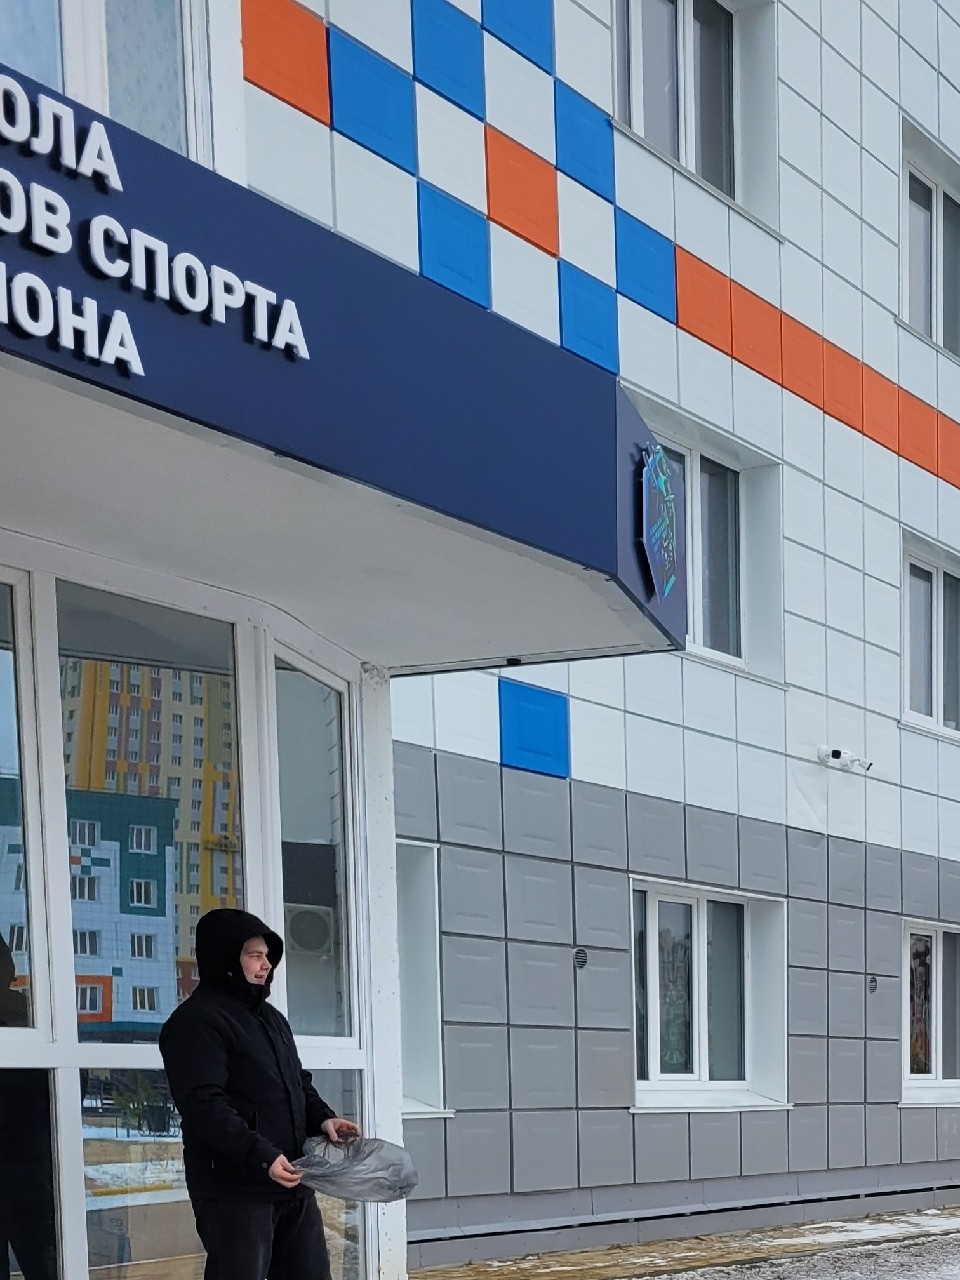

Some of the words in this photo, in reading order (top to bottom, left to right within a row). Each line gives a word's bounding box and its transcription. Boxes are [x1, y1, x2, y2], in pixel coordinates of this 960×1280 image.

[0, 74, 123, 192] ОЛА
[0, 262, 145, 376] ОНА
[89, 215, 310, 359] СПОРТА
